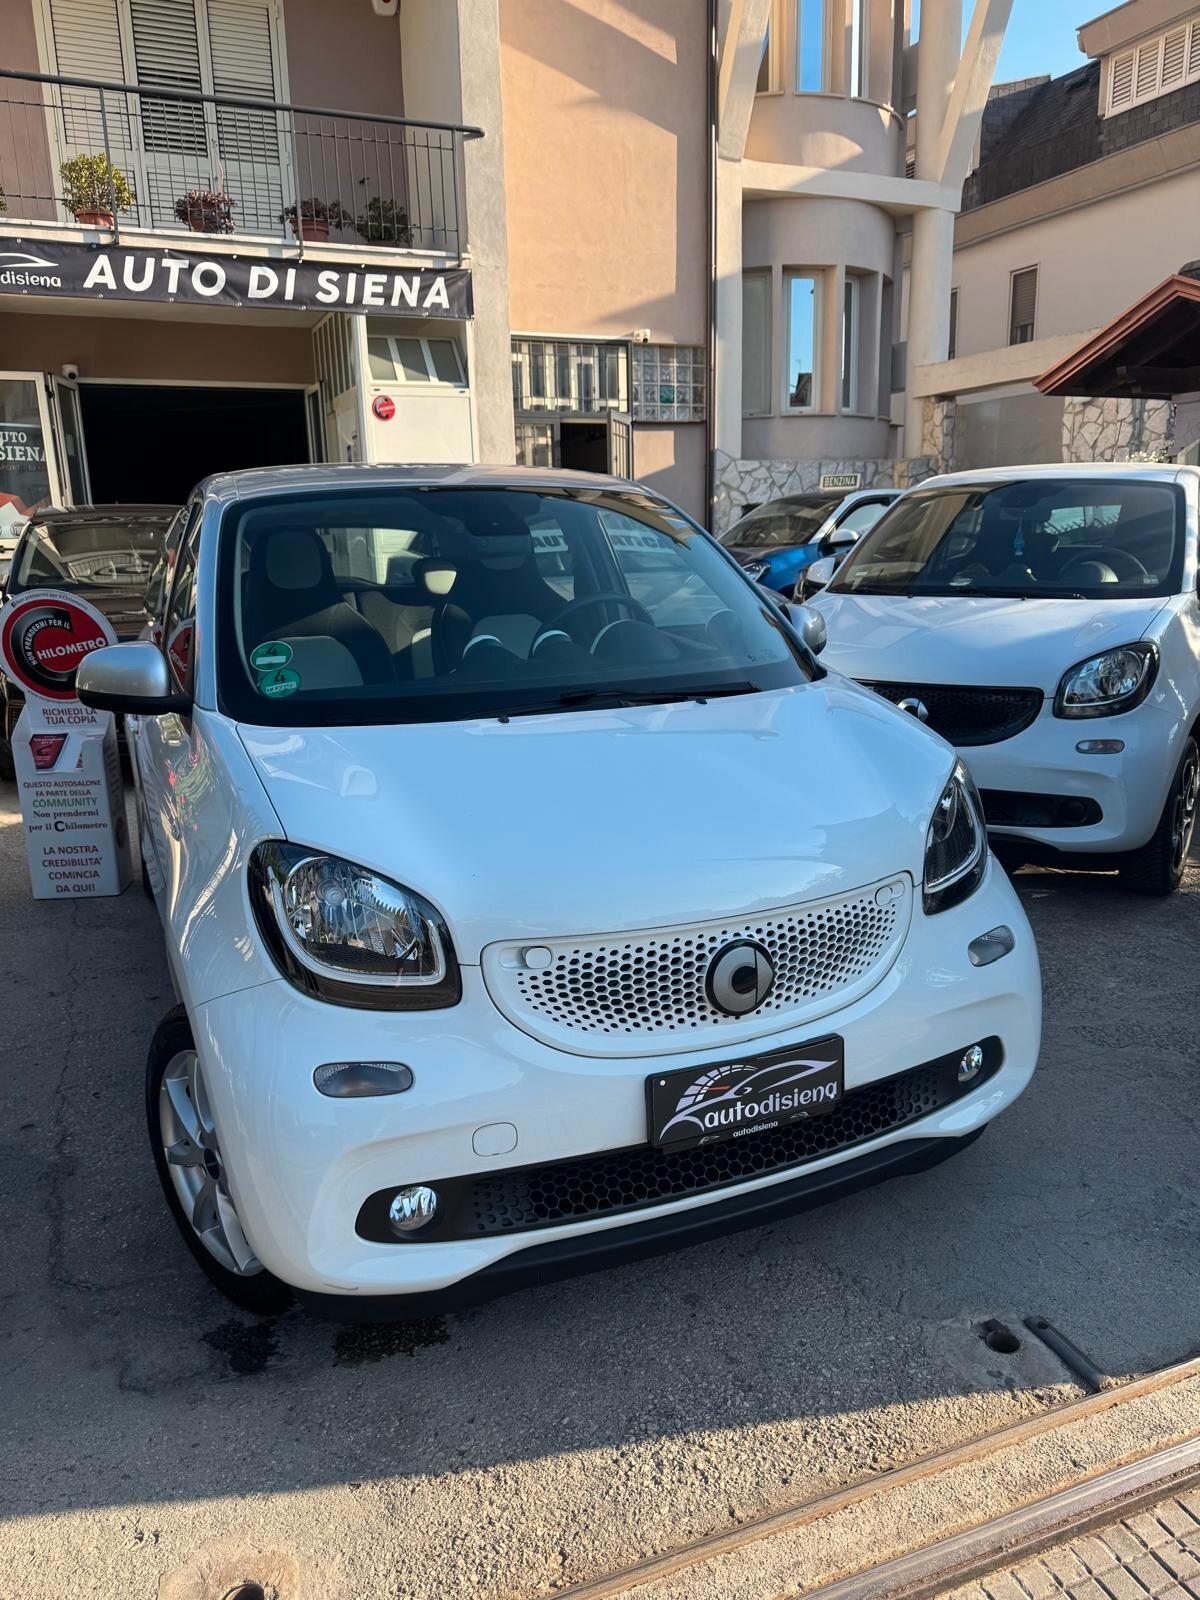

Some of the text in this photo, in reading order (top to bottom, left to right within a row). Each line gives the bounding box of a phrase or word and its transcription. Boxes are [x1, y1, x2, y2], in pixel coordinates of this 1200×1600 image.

[83, 254, 450, 309] AUTO DI SIENA
[824, 476, 856, 487] BENZINA
[24, 619, 71, 666] NON PRENDERMI PER IL
[42, 706, 97, 717] RICHIEDI LA
[45, 715, 97, 725] TUA COPIA
[23, 779, 102, 789] QUESTO AUTOSALONE
[32, 797, 97, 808] COMMUNITY
[33, 808, 99, 820] Non prendermi
[28, 820, 108, 833] per il Chilometro
[43, 845, 99, 855] LA NOSTRA
[42, 857, 103, 868] CREDIBILITA'
[48, 870, 101, 880] COMINCIA
[56, 883, 96, 893] DA QUI!
[704, 1080, 838, 1128] autodisiena
[732, 1120, 779, 1138] autodisiena
